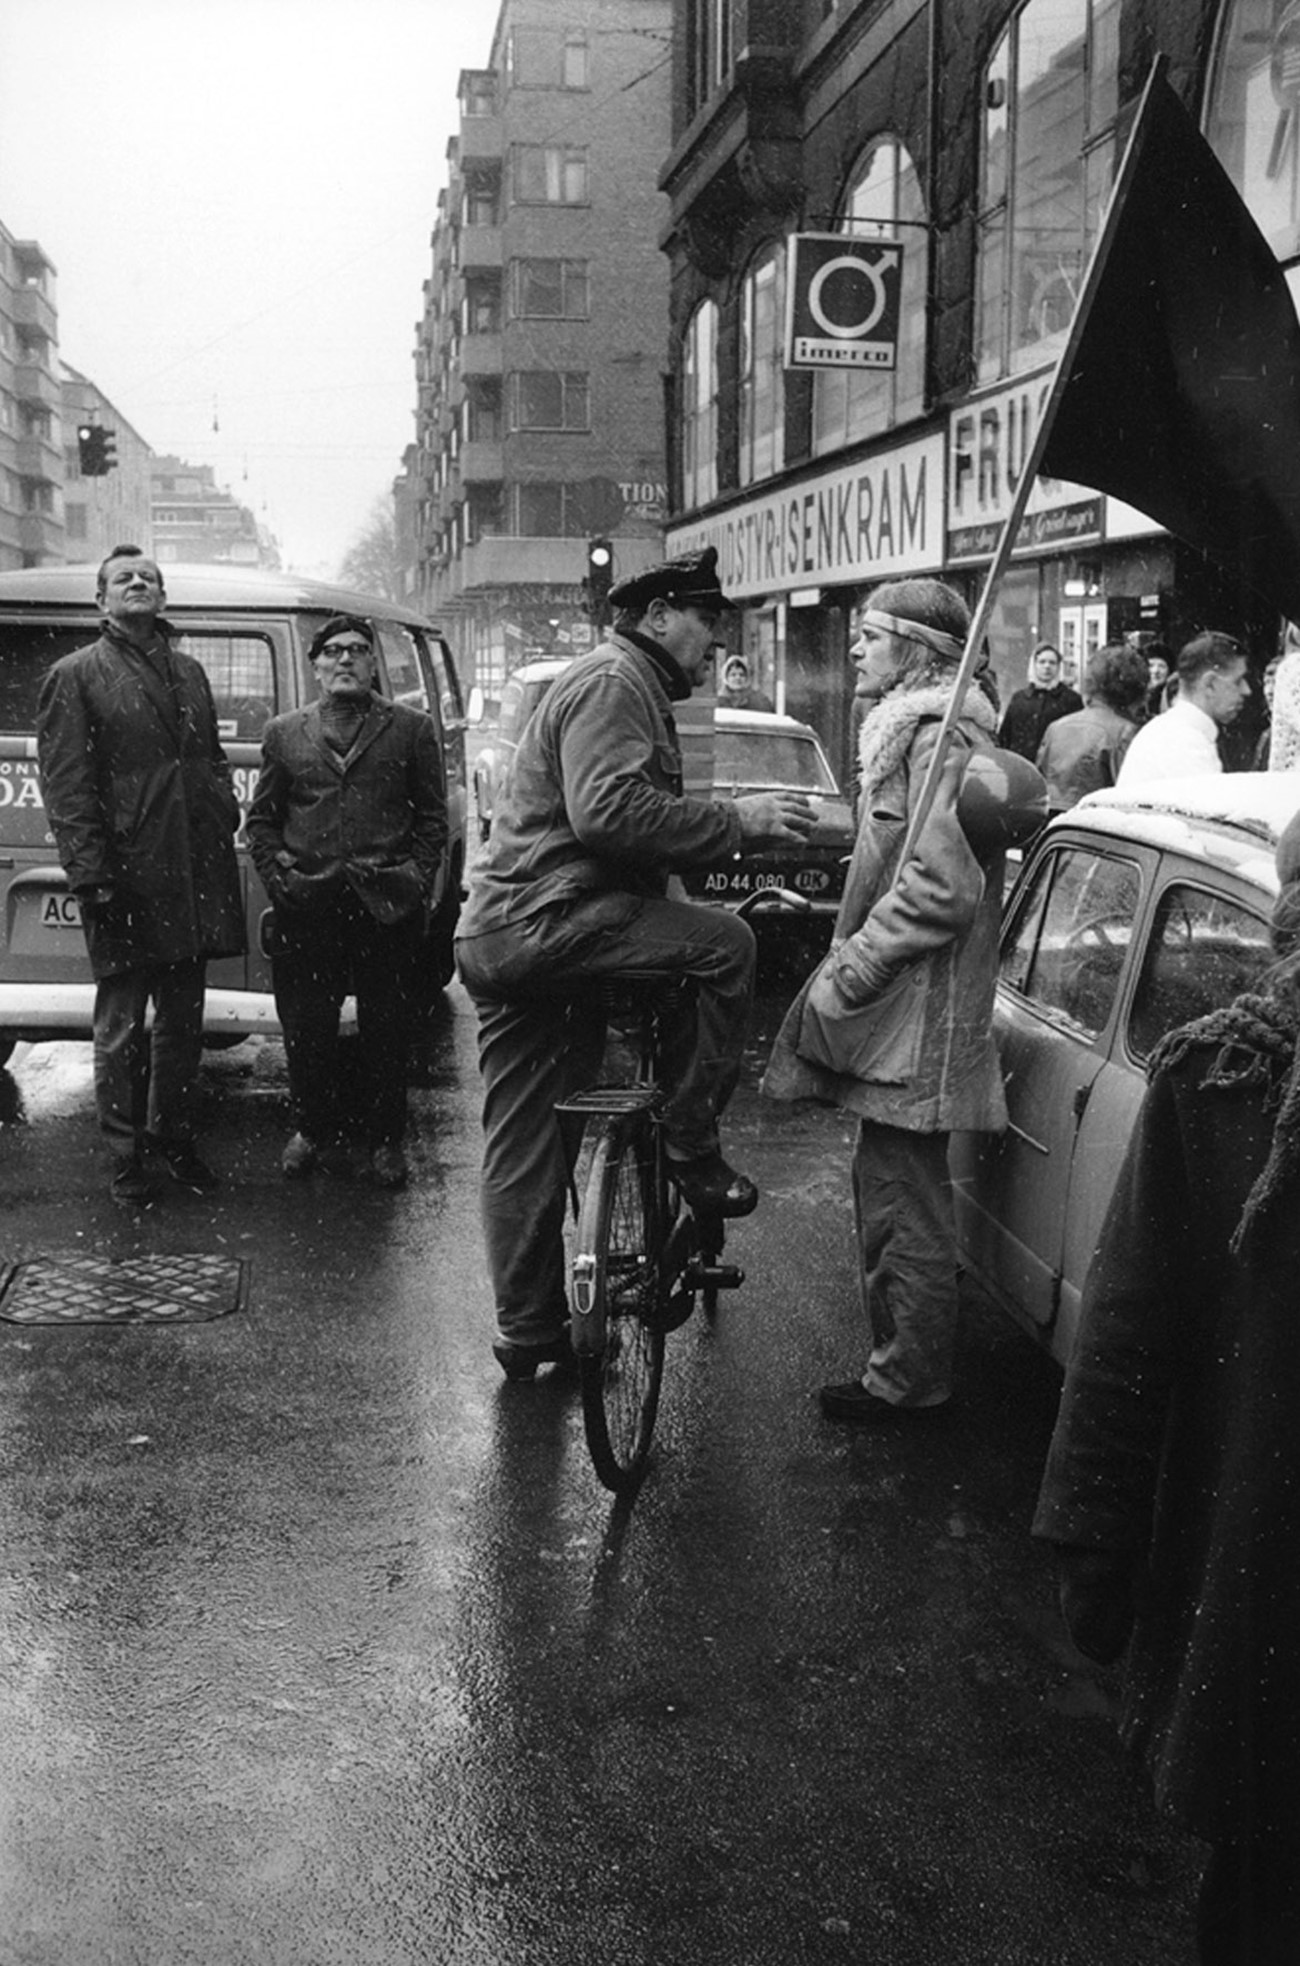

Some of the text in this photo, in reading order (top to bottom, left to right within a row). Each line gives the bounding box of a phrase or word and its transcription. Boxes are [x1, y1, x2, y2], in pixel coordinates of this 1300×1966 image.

[801, 340, 888, 362] imerco
[704, 872, 729, 891] AD
[799, 871, 824, 889] DK
[43, 896, 78, 922] AC
